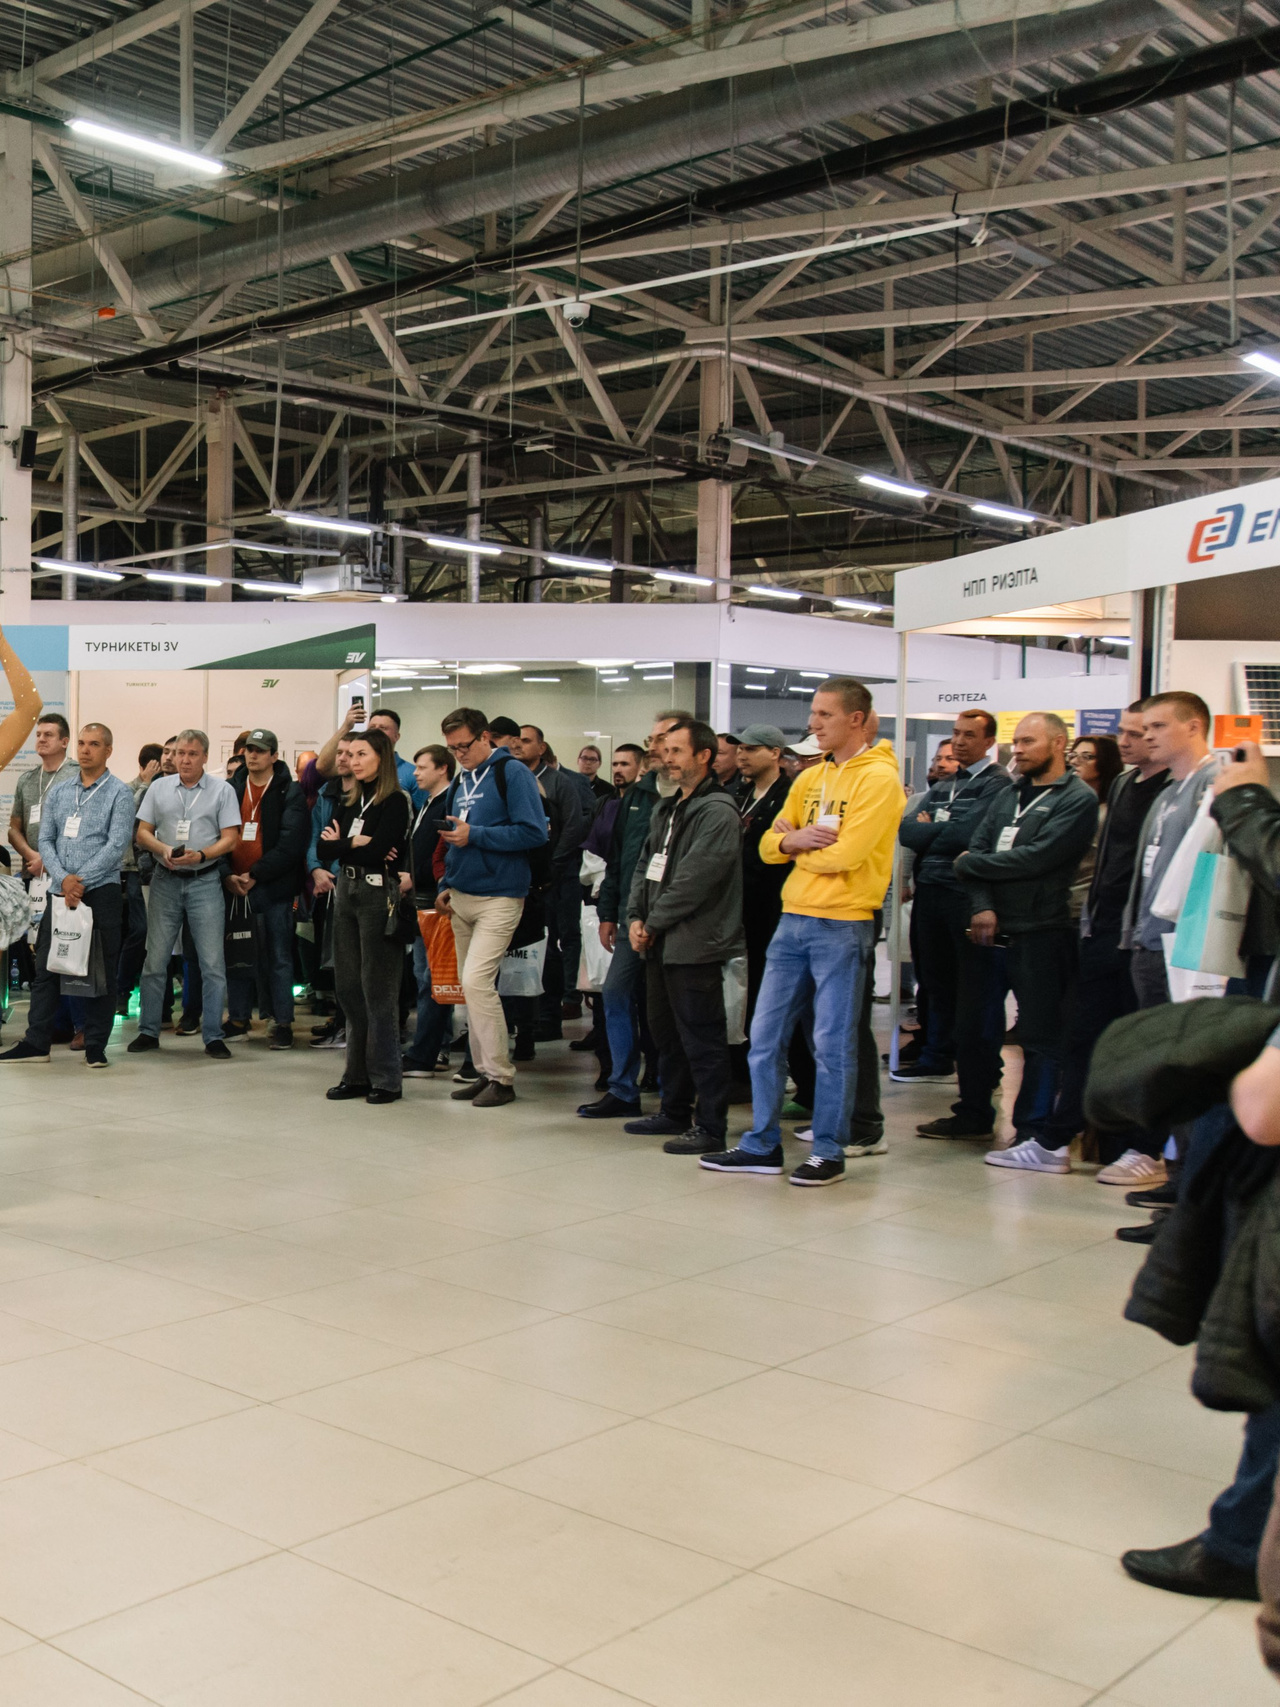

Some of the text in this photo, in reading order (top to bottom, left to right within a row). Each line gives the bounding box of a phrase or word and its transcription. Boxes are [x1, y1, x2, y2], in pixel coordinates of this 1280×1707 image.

[963, 567, 1039, 598] НПП РИЭЛТА
[85, 641, 179, 652] ТУРНИКЕТЫ 3V
[938, 693, 988, 703] FORTEZA
